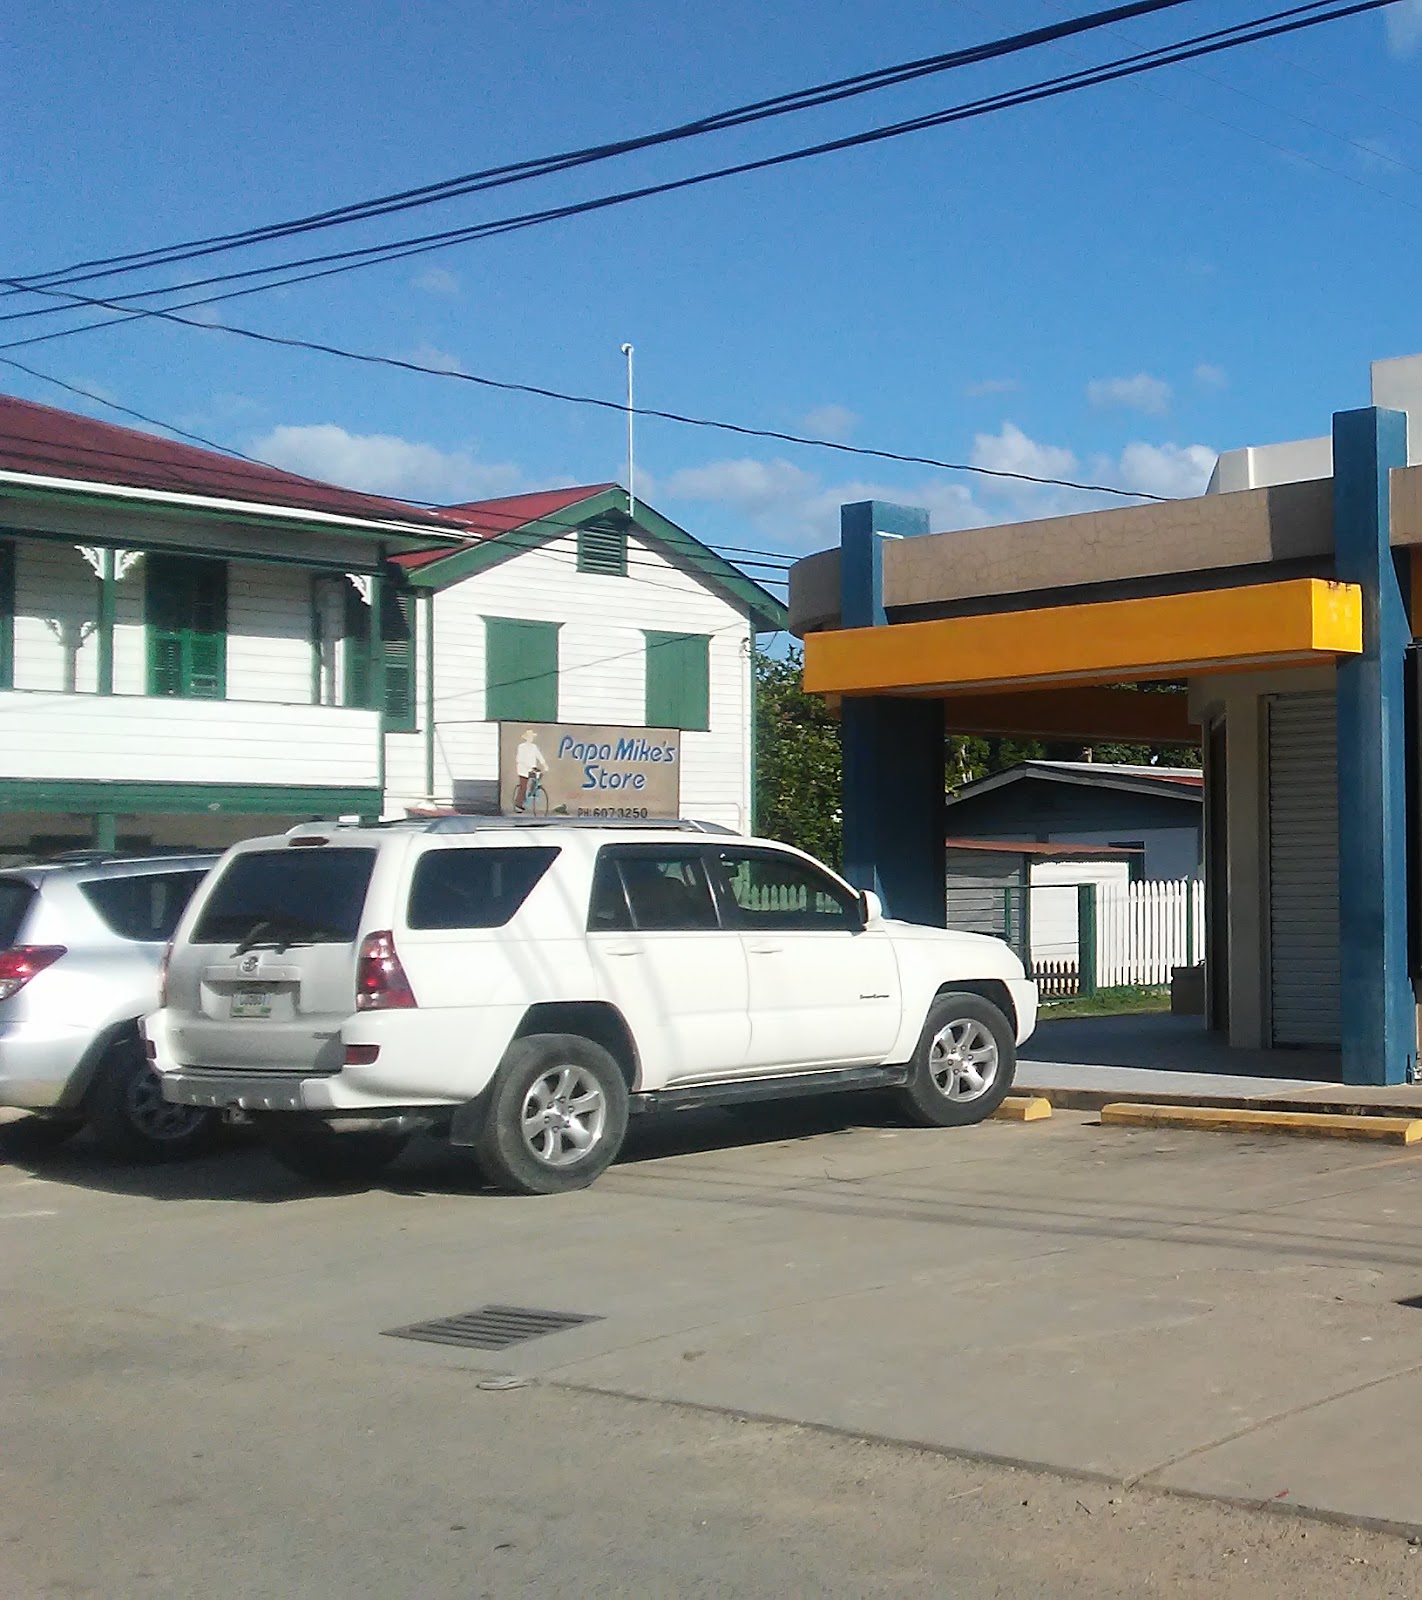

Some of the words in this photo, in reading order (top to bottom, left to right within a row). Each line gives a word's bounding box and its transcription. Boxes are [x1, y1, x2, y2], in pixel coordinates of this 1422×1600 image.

[558, 734, 612, 764] Papa
[613, 737, 676, 763] Mike's
[580, 764, 647, 790] Store
